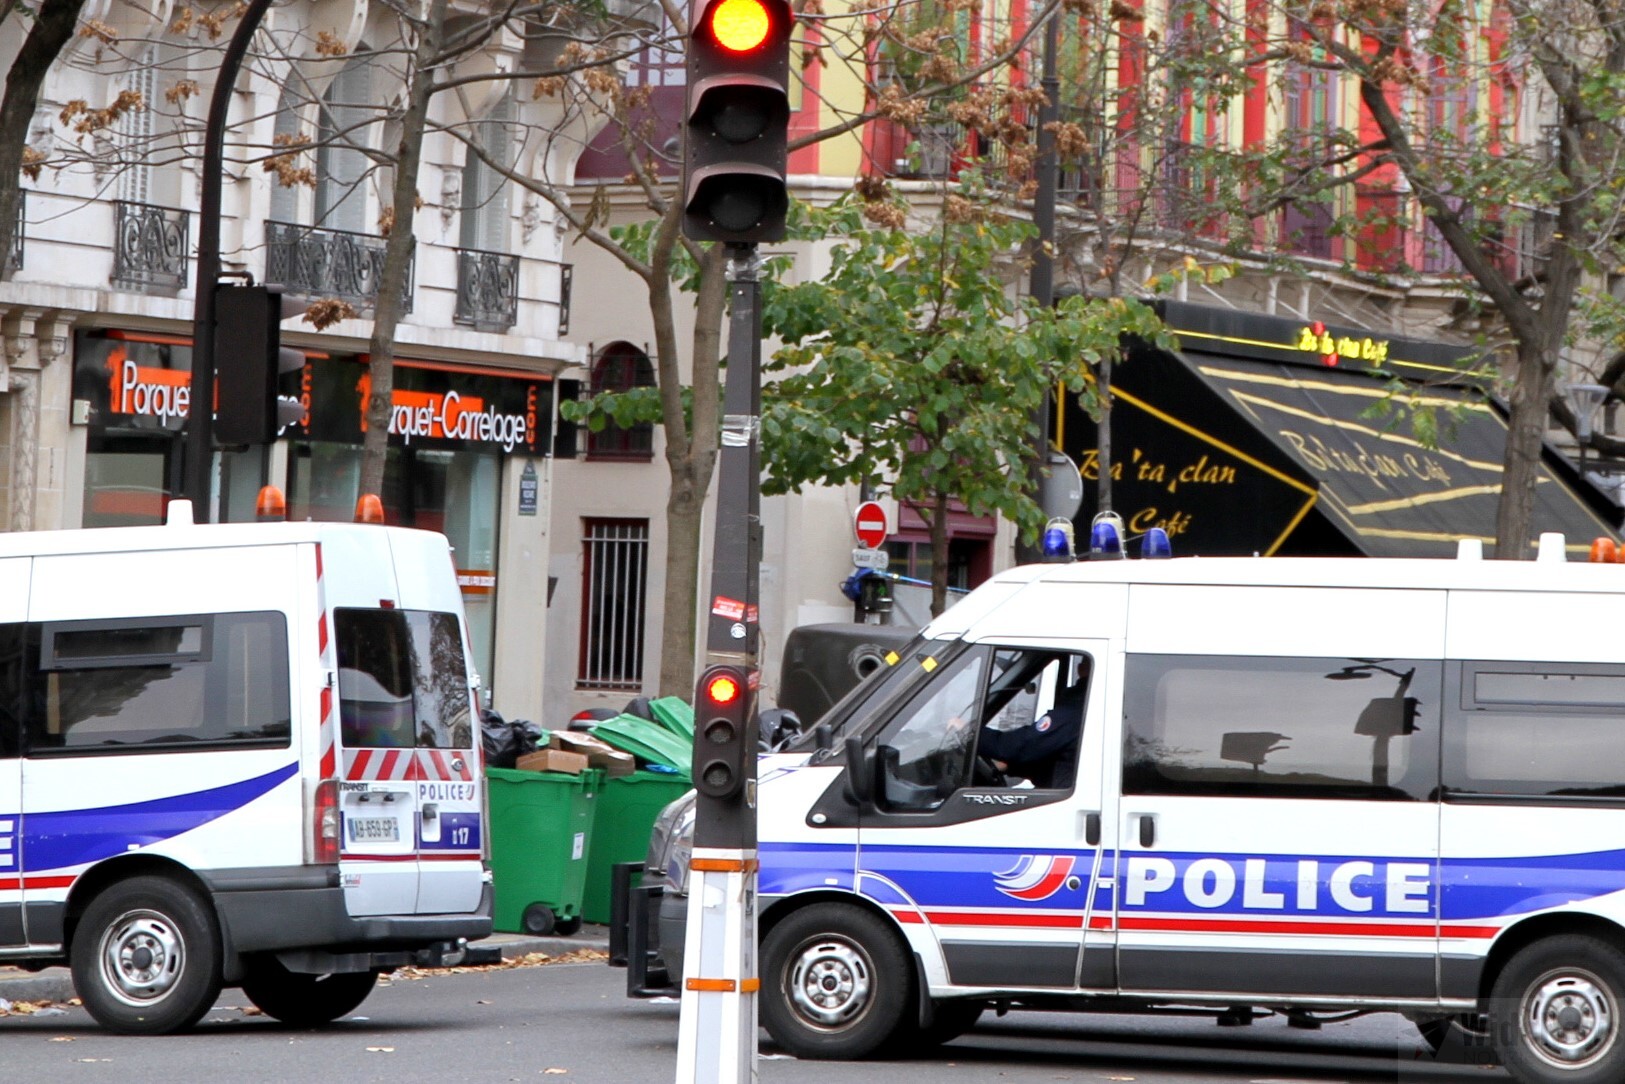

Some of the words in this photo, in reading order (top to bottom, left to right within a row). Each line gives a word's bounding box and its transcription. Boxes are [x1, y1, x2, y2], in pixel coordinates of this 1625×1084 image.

[388, 390, 526, 452] rquet-Carrelage
[419, 784, 464, 800] POLICE
[962, 793, 1028, 805] TRANSIT
[1125, 857, 1431, 913] POLICE
